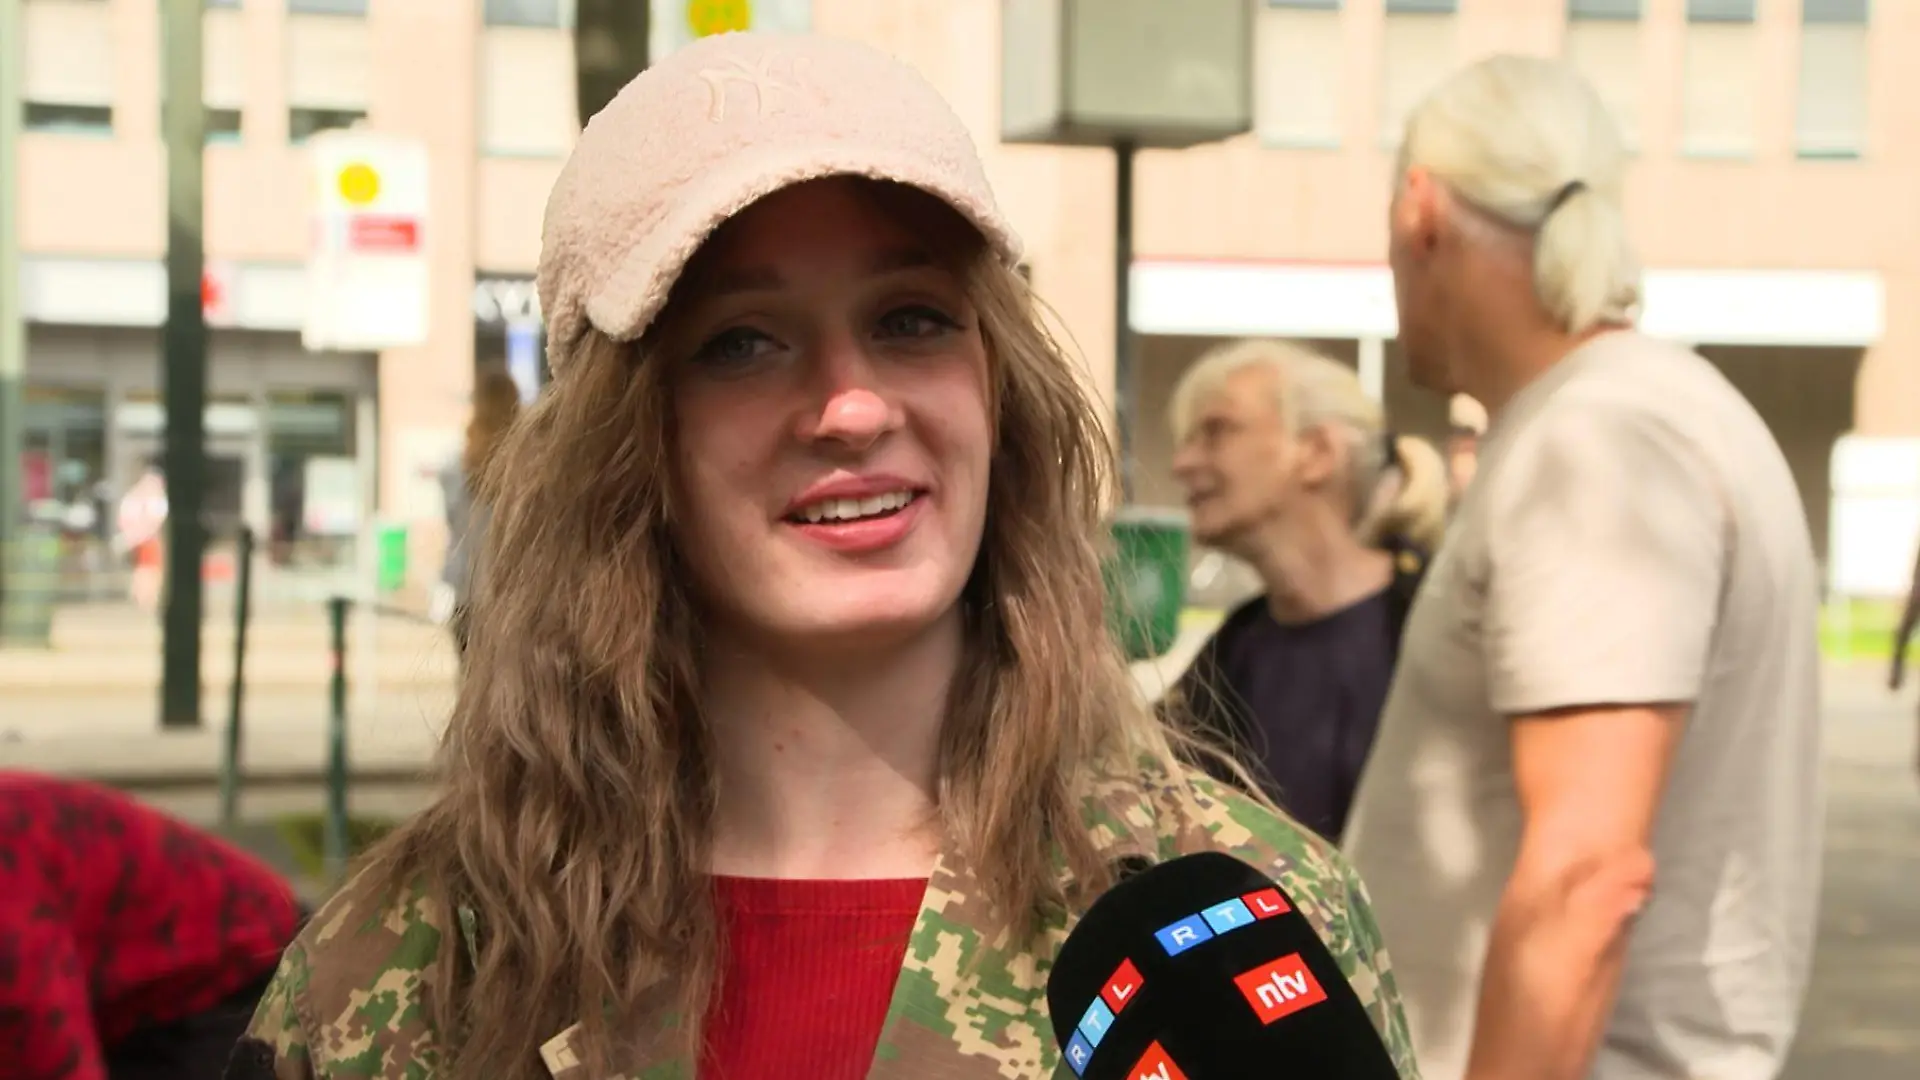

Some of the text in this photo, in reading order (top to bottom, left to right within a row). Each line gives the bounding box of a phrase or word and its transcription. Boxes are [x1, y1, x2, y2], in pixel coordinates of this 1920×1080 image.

[1170, 897, 1280, 947] RTL
[1255, 969, 1309, 1009] ntv
[1071, 983, 1133, 1065] RTL
